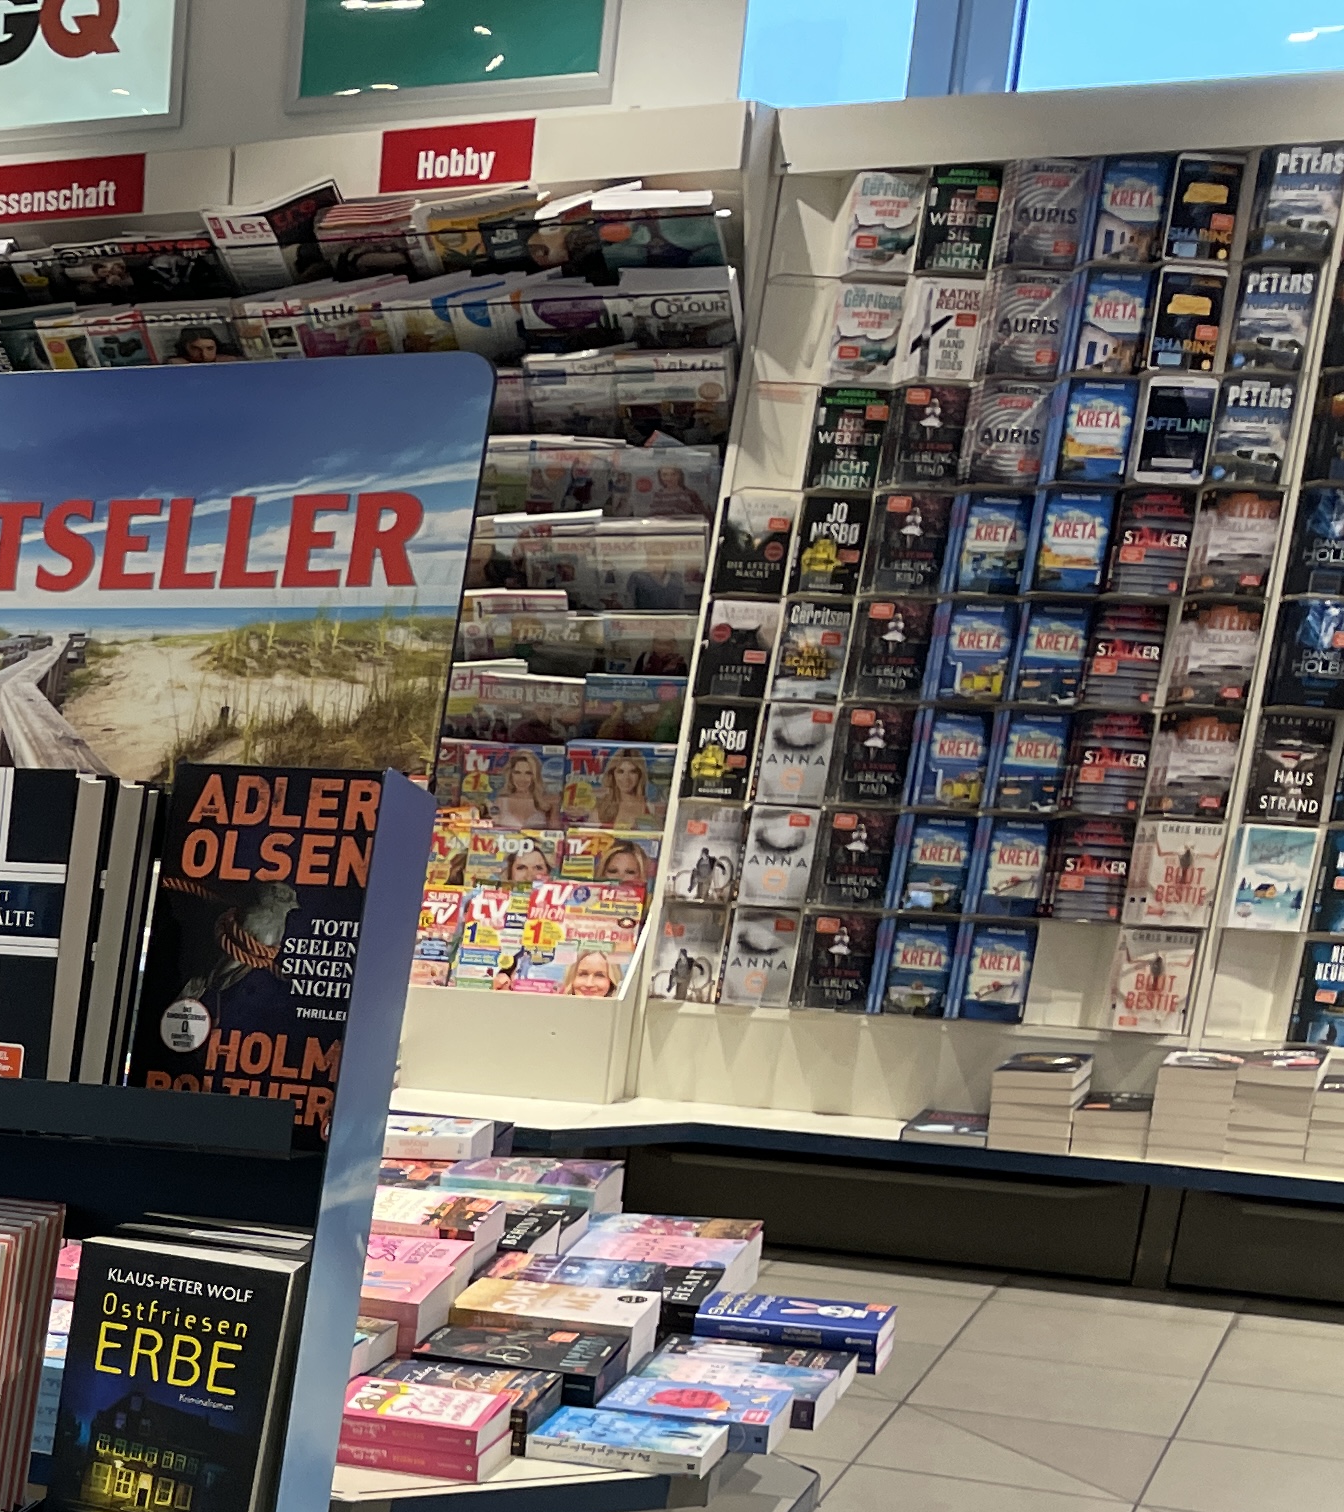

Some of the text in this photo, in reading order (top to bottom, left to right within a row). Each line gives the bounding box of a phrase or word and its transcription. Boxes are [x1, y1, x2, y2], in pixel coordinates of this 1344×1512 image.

[417, 148, 496, 181] Hobby
[930, 212, 994, 228] WERDET
[1018, 206, 1079, 224] AURIS
[1246, 273, 1314, 295] PETERS
[936, 299, 981, 311] REICHS
[940, 290, 981, 300] KATHY
[826, 502, 849, 522] JO
[1123, 530, 1188, 549] STALKER
[765, 752, 827, 767] ANNA
[1273, 769, 1315, 788] HAUS
[188, 773, 382, 831] ADLER
[1259, 794, 1320, 814] STRAND
[497, 832, 535, 855] top
[181, 828, 374, 888] OLSEN
[748, 853, 808, 869] ANNA
[205, 1028, 342, 1083] HOLM
[108, 1267, 254, 1303] KLAUS-PETER WOLF
[103, 1292, 248, 1338] Ostfriesen
[94, 1321, 243, 1396] ERBE
